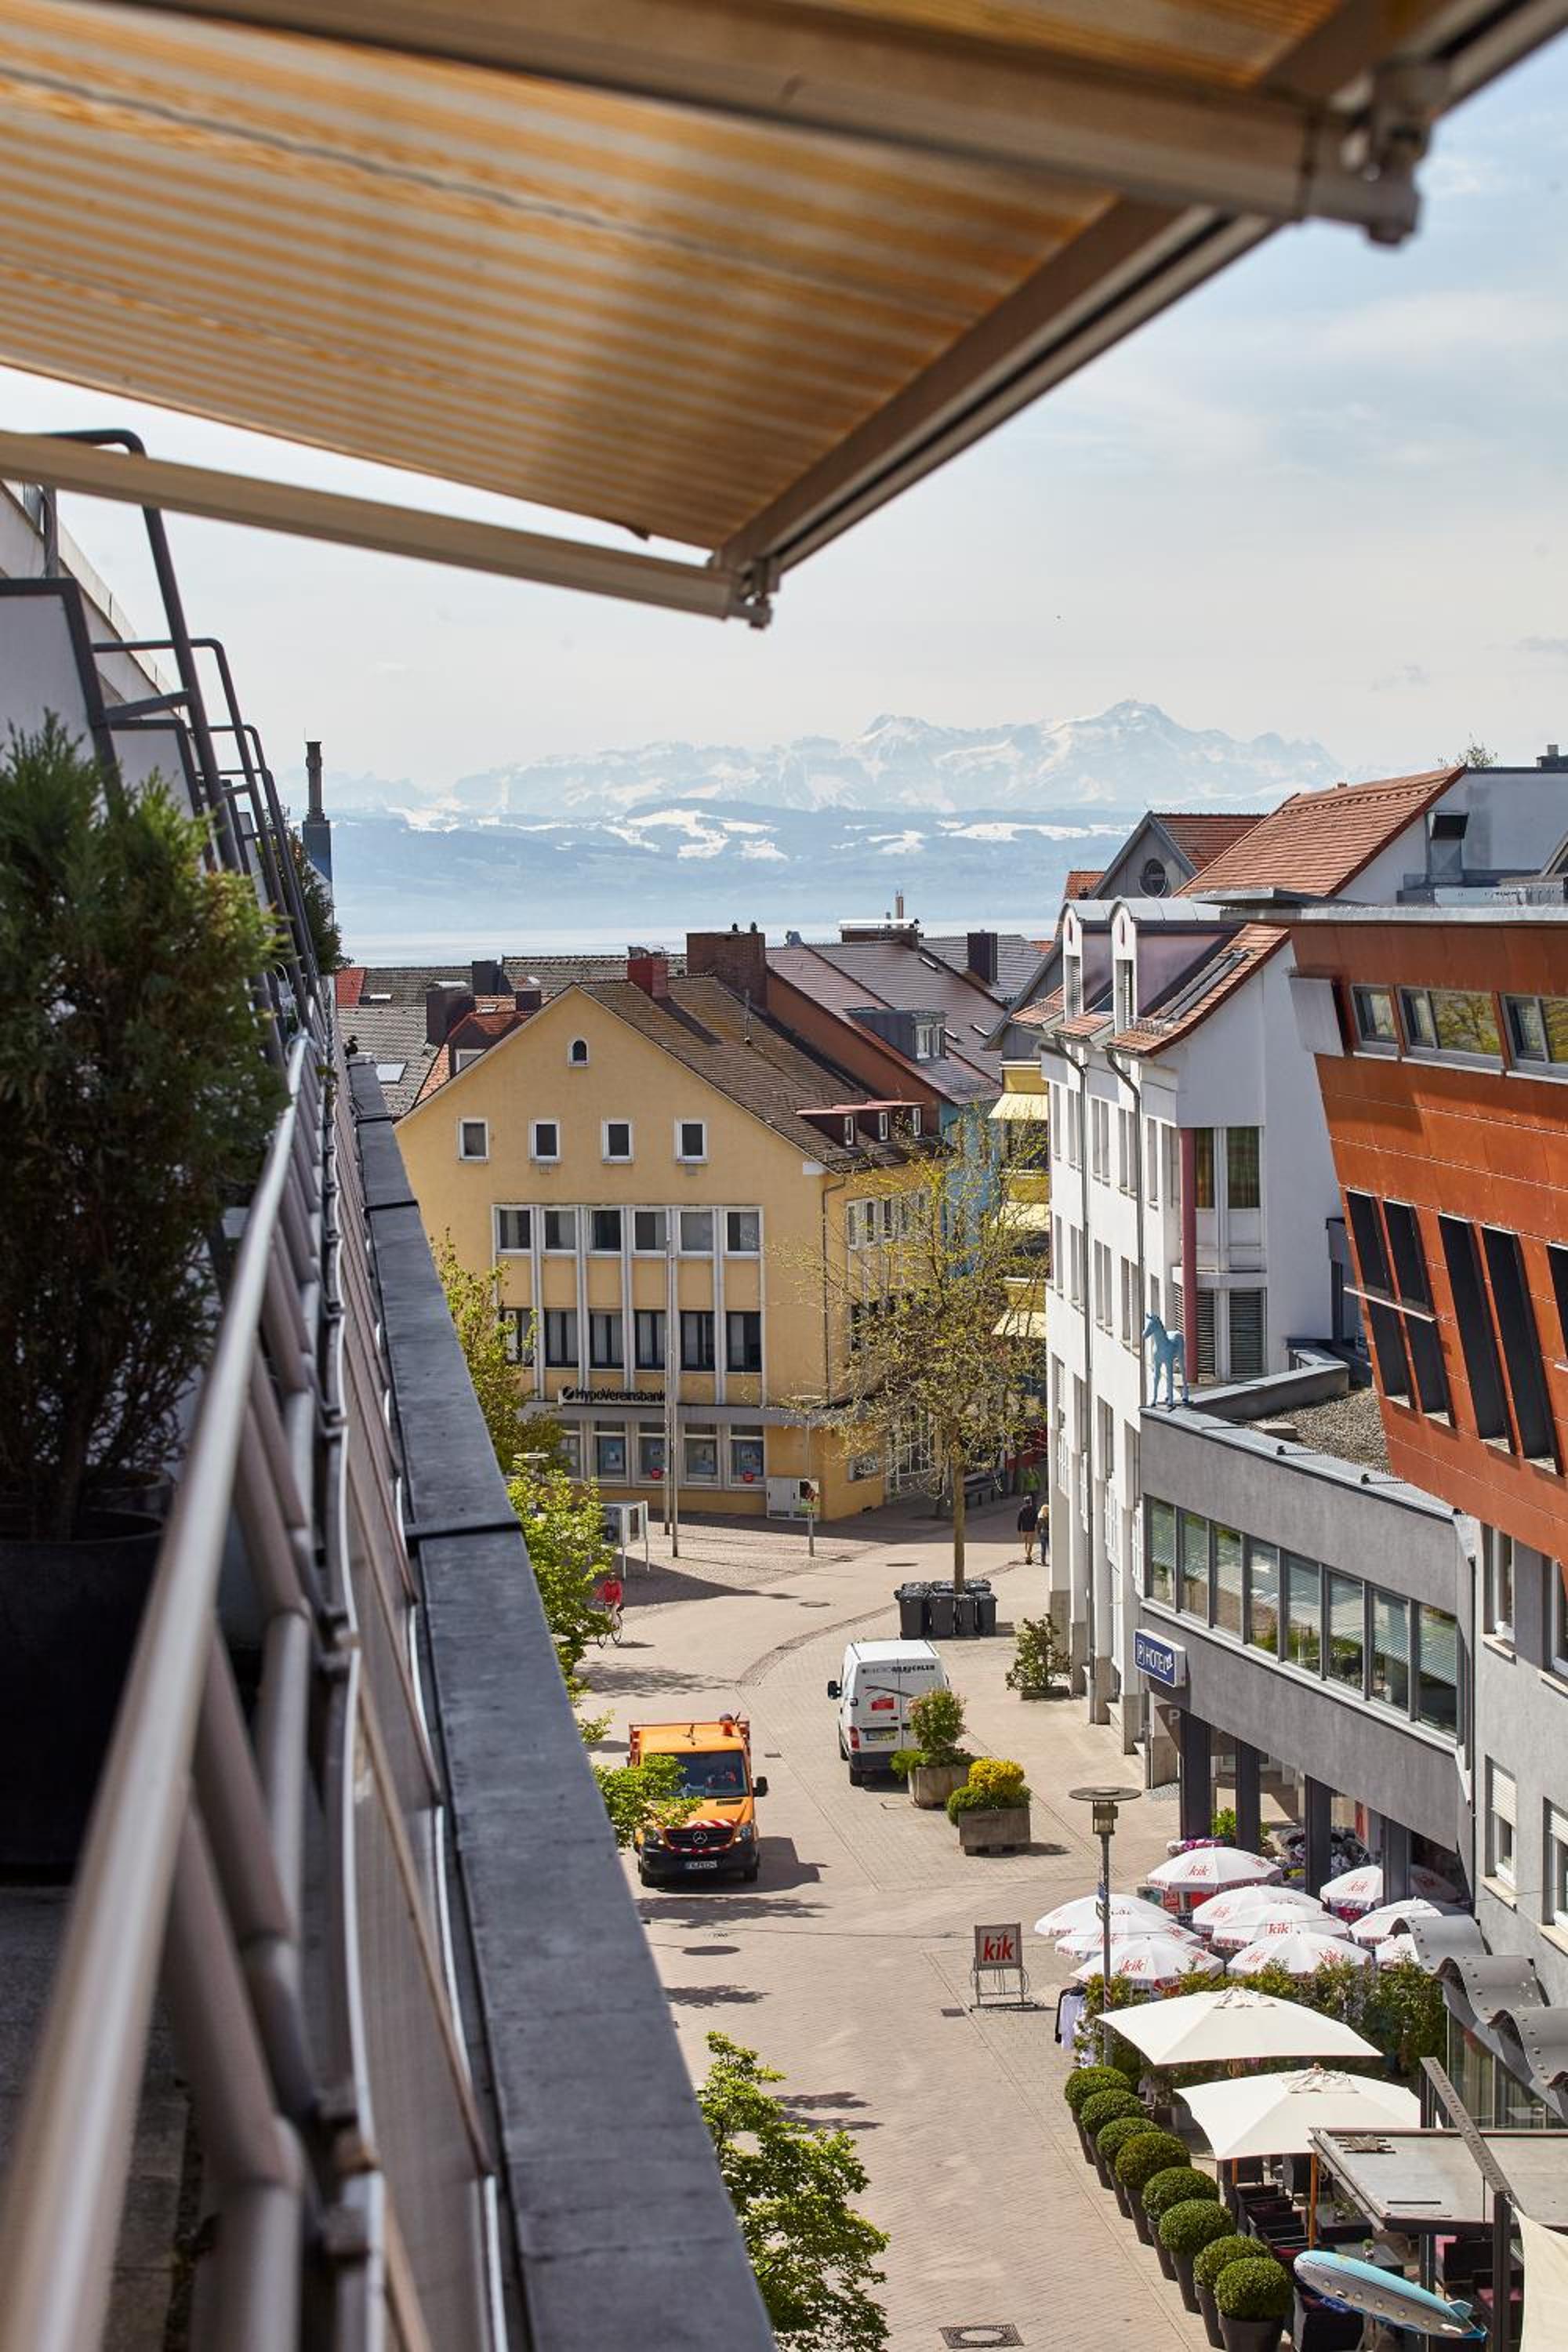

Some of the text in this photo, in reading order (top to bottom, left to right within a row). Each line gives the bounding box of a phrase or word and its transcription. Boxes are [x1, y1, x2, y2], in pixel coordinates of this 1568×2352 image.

[576, 1387, 665, 1402] HypoVereinsbank
[1145, 1646, 1167, 1675] HOTEL
[1188, 1865, 1209, 1876] kik
[1268, 1922, 1290, 1934] kik
[983, 1931, 1014, 1962] kik
[1121, 1958, 1144, 1973] kik
